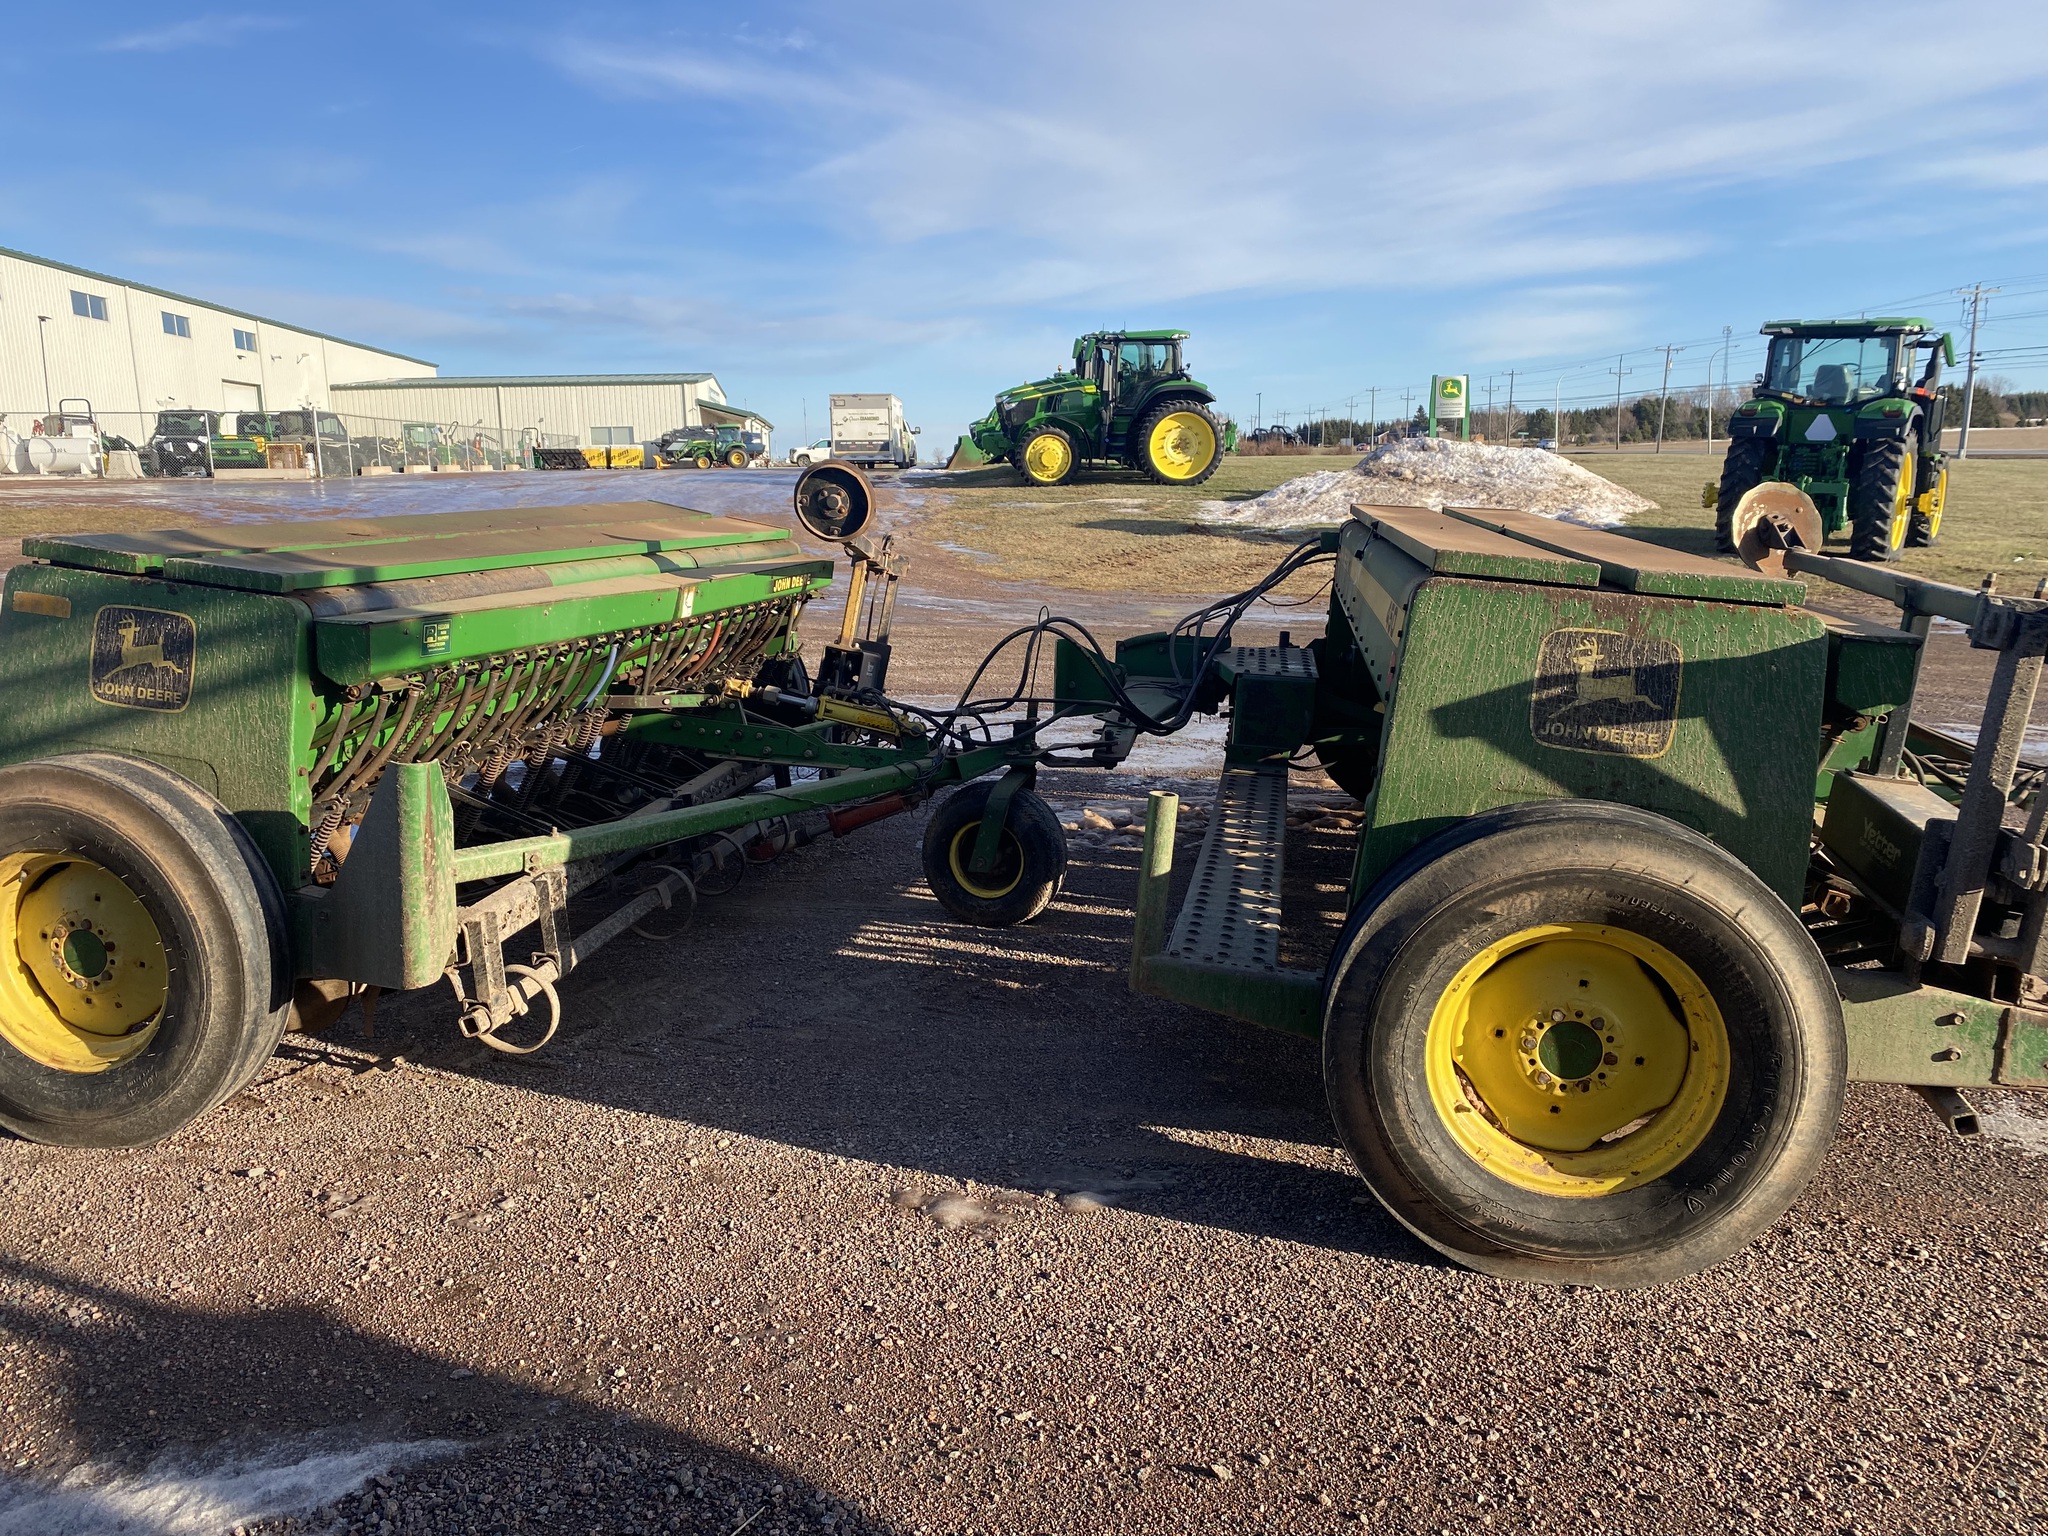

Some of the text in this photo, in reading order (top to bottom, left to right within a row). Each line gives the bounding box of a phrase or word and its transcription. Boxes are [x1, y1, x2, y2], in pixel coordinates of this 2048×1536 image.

[773, 574, 812, 593] JOHN DEERE
[97, 682, 182, 704] JOHN DEERE
[1540, 721, 1660, 748] JOHN DEERE
